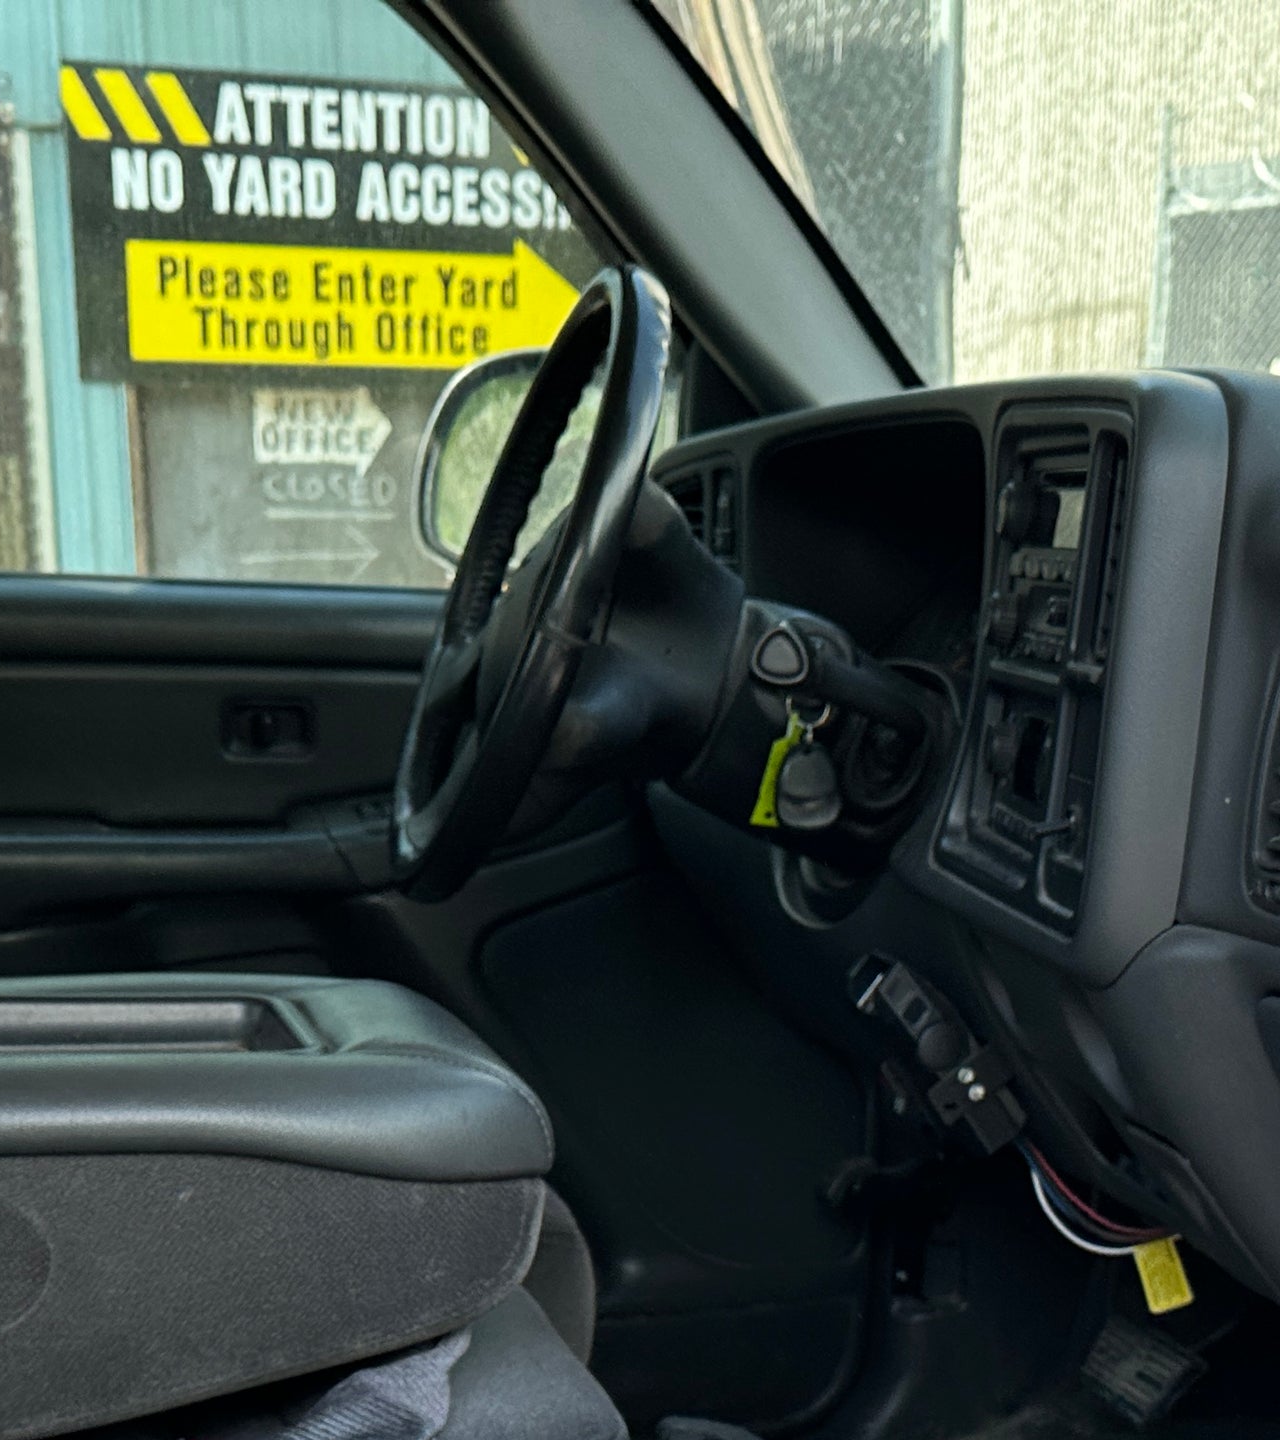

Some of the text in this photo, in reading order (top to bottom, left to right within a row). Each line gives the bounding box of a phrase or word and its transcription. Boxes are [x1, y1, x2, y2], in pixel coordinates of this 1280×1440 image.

[214, 81, 491, 158] ATTENTION
[110, 147, 185, 213] NO
[203, 152, 337, 219] YARD
[157, 254, 519, 310] Please Enter Yard
[194, 305, 490, 358] Through Office
[261, 421, 376, 454] OFFICE
[261, 471, 398, 507] CLOSED
